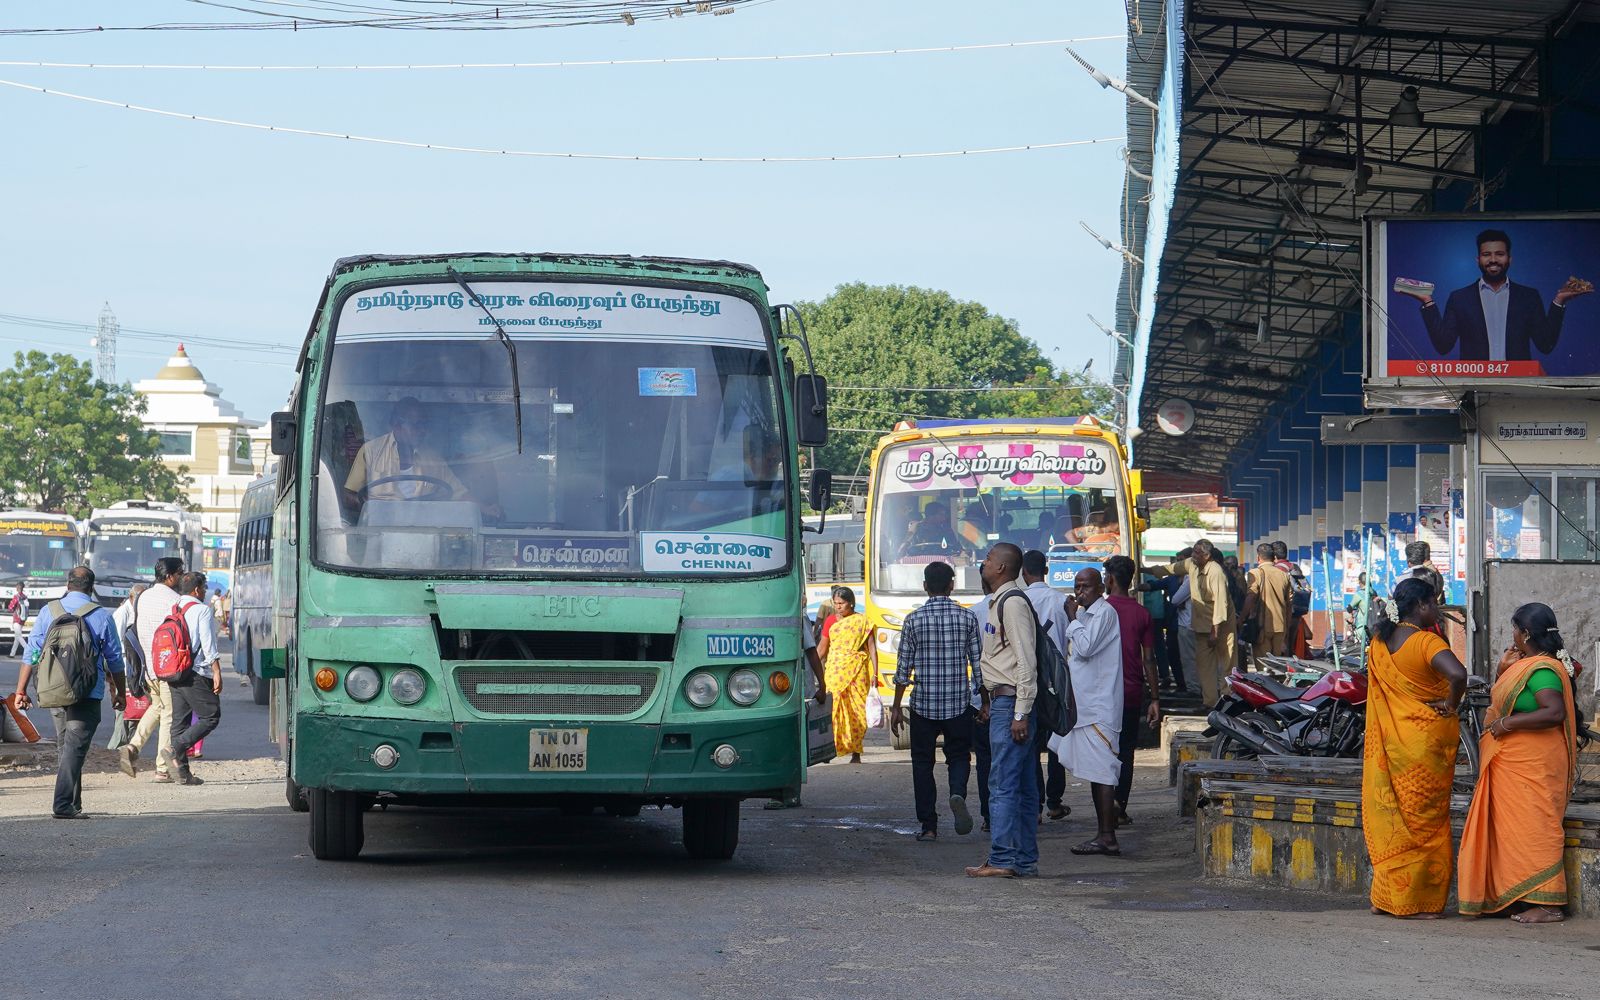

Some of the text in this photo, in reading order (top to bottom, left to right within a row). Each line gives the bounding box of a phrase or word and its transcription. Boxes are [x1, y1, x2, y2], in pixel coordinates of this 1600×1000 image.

[356, 289, 721, 317] தமிழ்நாடு அரசு விரைவுப் பேருந்து
[539, 316, 602, 330] பேருந்து
[1430, 363, 1509, 373] 810 8000 847
[1564, 427, 1586, 438] அறை
[934, 449, 1105, 481] சிதம்பரவிலாஸ்
[522, 540, 630, 564] சென்னை
[655, 535, 773, 559] சென்னை
[681, 559, 752, 570] CHENNAI
[543, 595, 601, 618] ETC
[708, 636, 774, 656] MDU C348
[538, 731, 578, 745] TN 01
[533, 753, 584, 768] AN 1055
